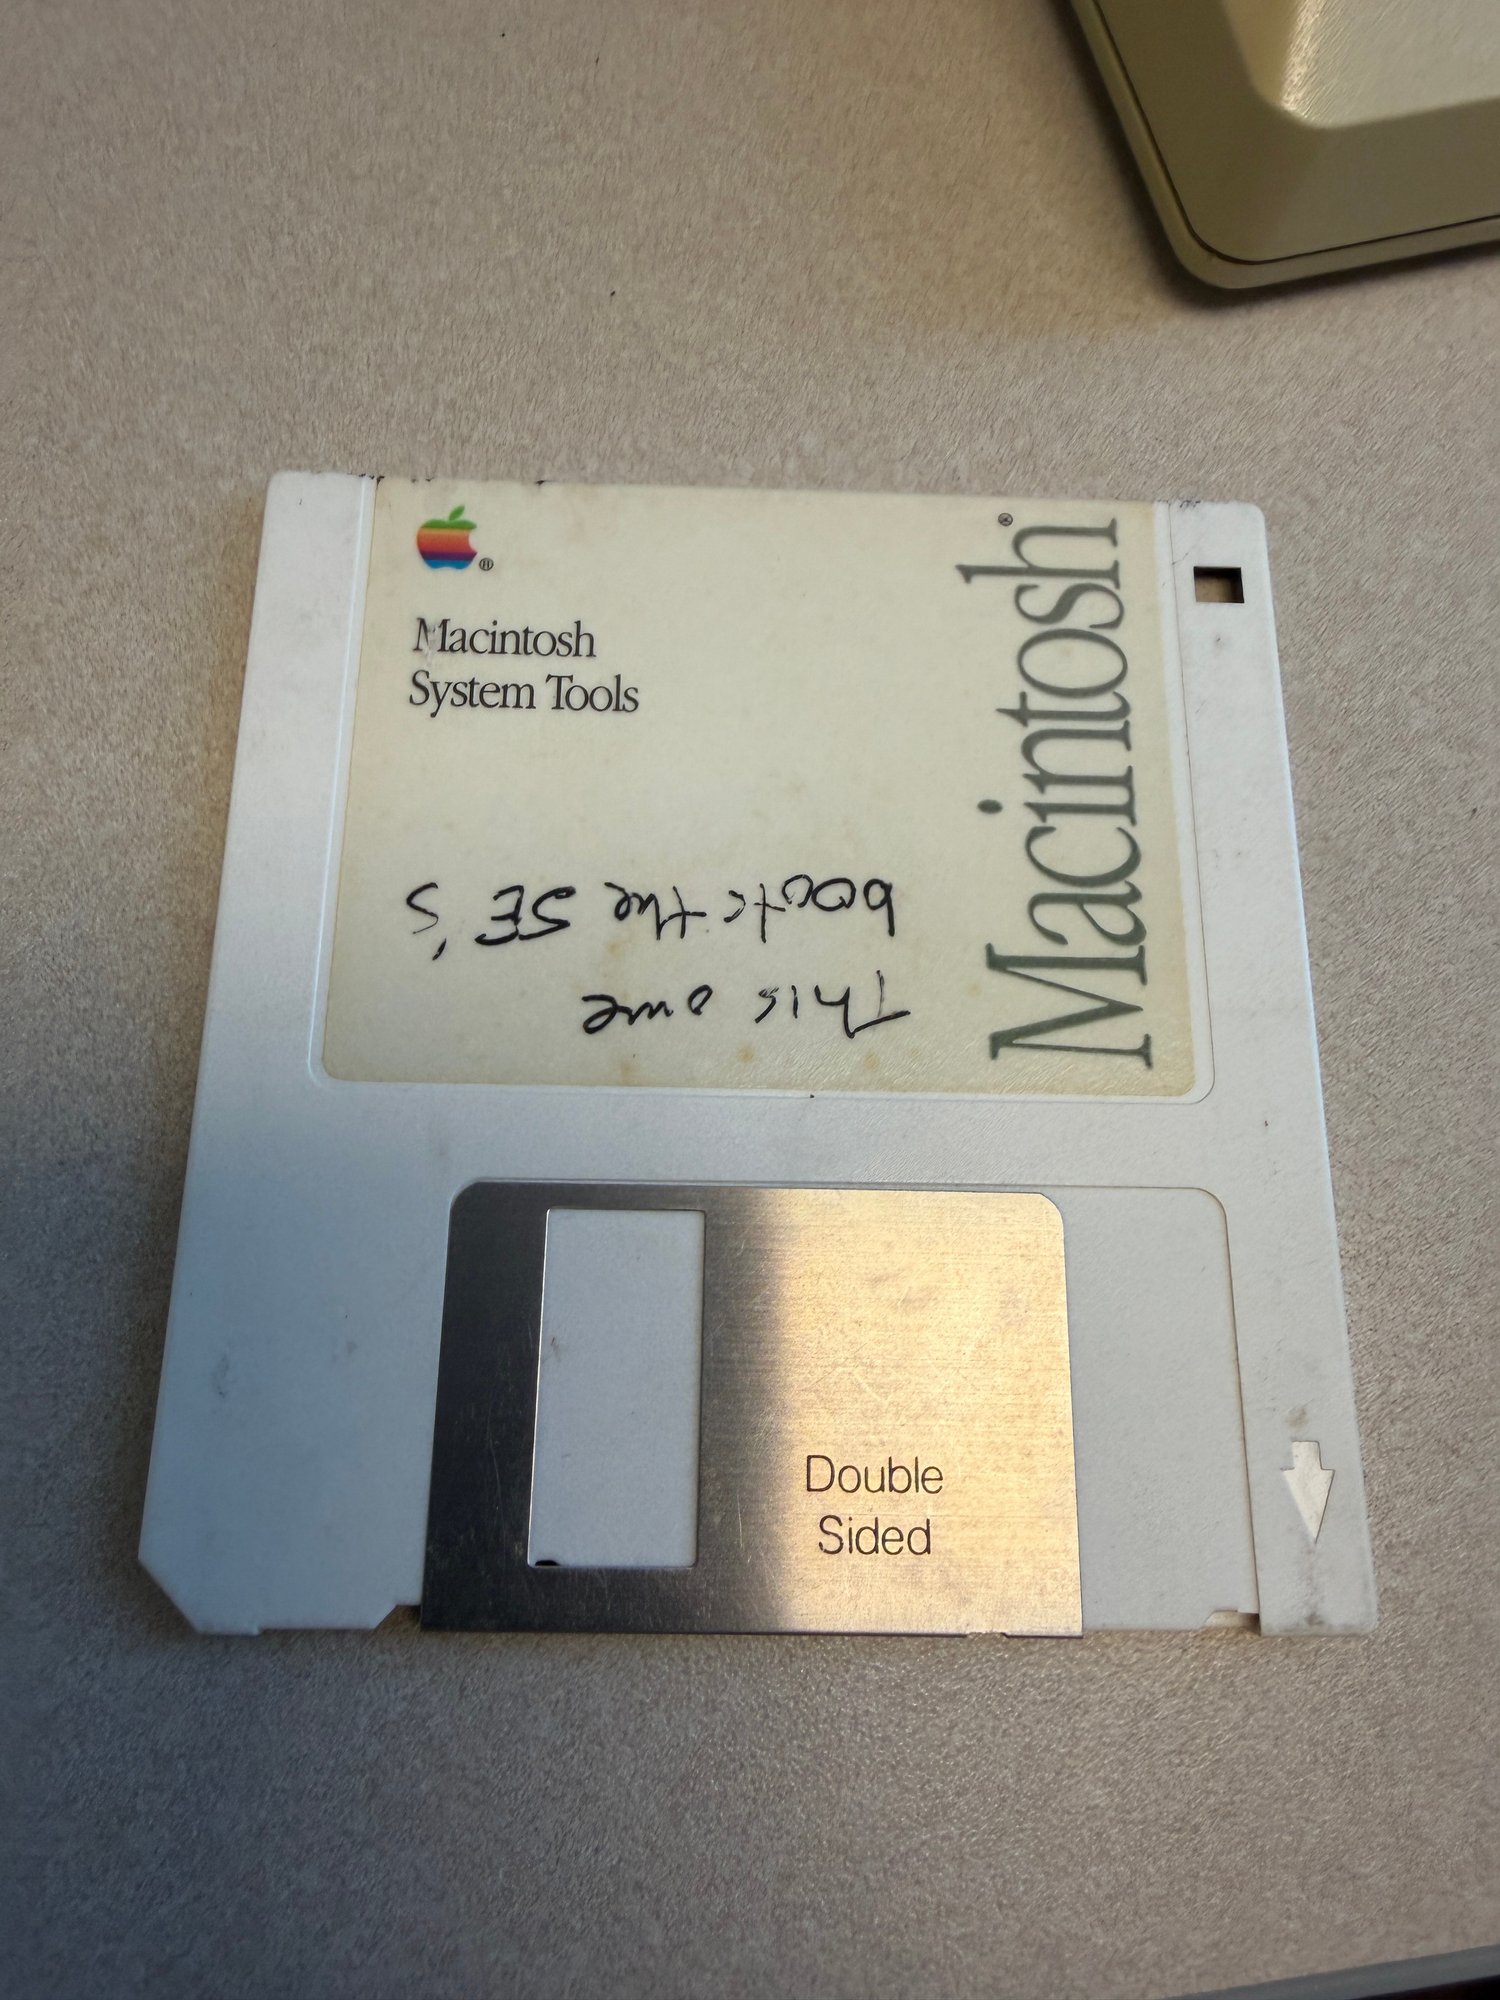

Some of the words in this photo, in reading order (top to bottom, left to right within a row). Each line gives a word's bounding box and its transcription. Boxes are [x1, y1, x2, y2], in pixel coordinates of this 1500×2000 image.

[413, 616, 597, 658] Macintosh
[409, 668, 537, 718] System
[545, 673, 640, 713] Tools
[955, 517, 1154, 1070] Macintosh
[603, 881, 708, 941] the
[723, 873, 896, 944] boots
[581, 984, 714, 1035] one
[754, 970, 911, 1039] This
[805, 1454, 944, 1494] Double
[818, 1514, 931, 1556] Sided
